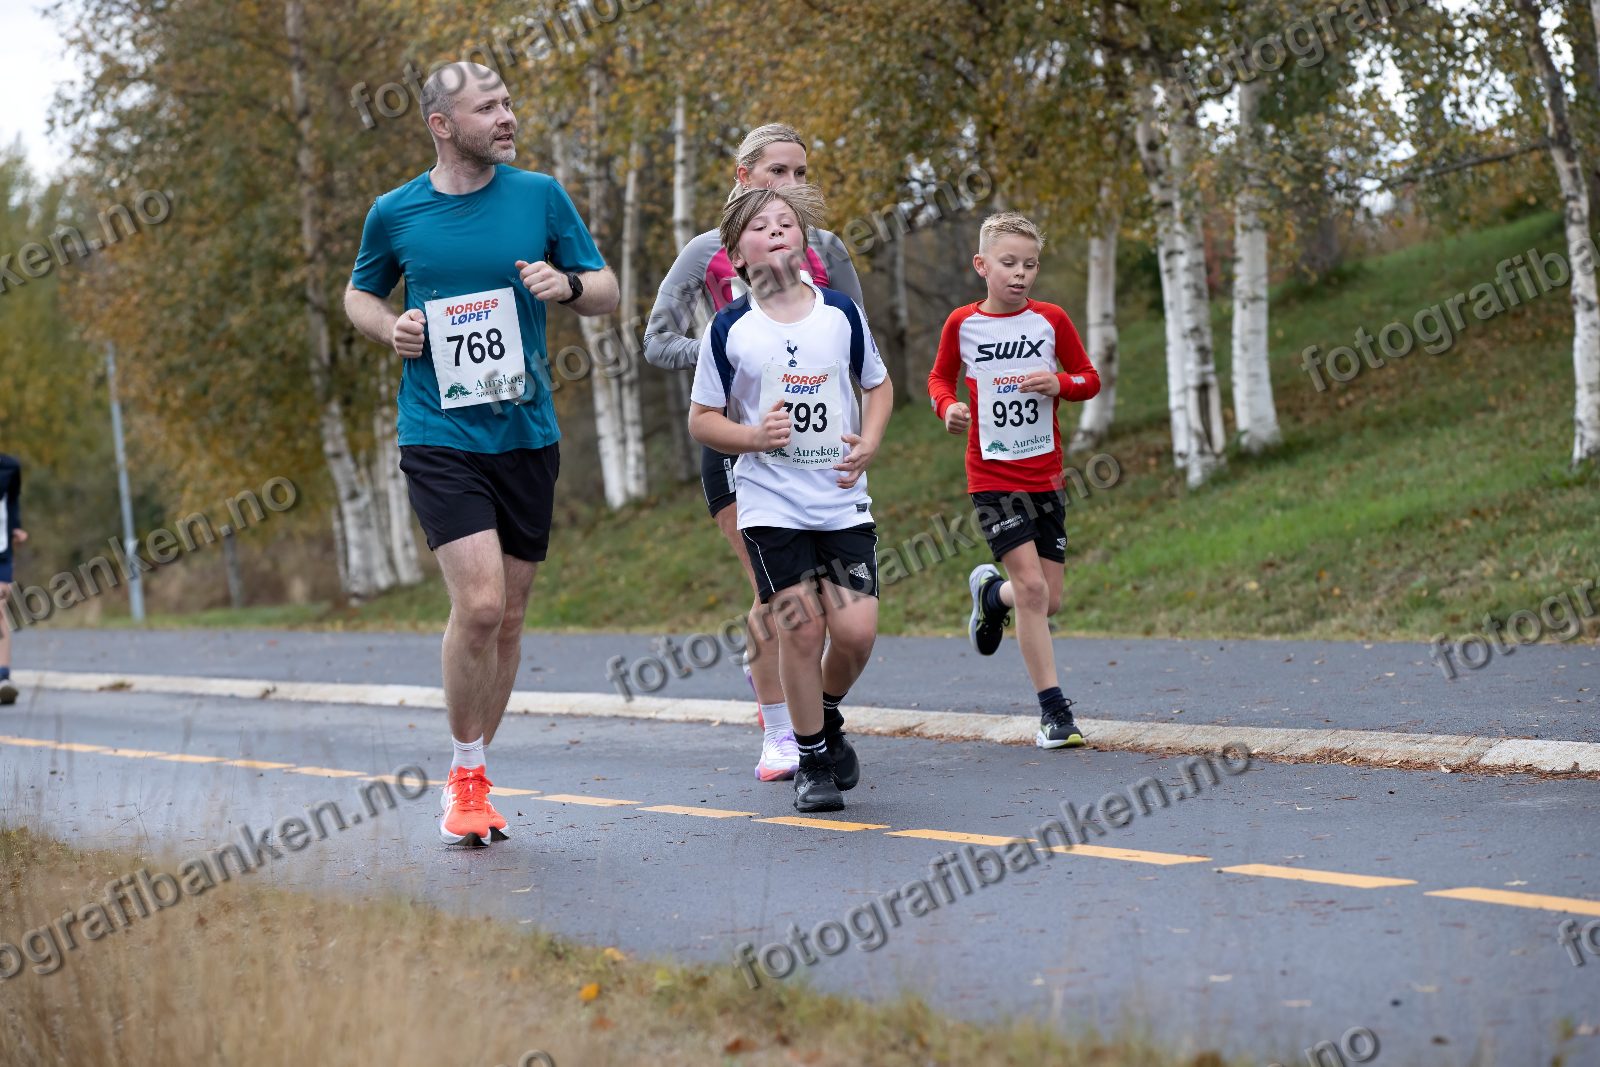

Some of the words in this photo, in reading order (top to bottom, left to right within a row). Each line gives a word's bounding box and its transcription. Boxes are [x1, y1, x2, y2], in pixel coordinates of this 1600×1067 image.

[445, 299, 499, 316] NORGES
[451, 310, 491, 325] LØPET
[446, 328, 505, 367] 768
[475, 374, 524, 391] Aurskog
[782, 373, 828, 385] NORGES
[993, 375, 1027, 385] NORG
[785, 384, 821, 394] LØPET
[997, 385, 1018, 393] LØP
[993, 399, 1038, 427] 933
[1012, 433, 1051, 448] Aurskog
[793, 445, 840, 457] Aurskog
